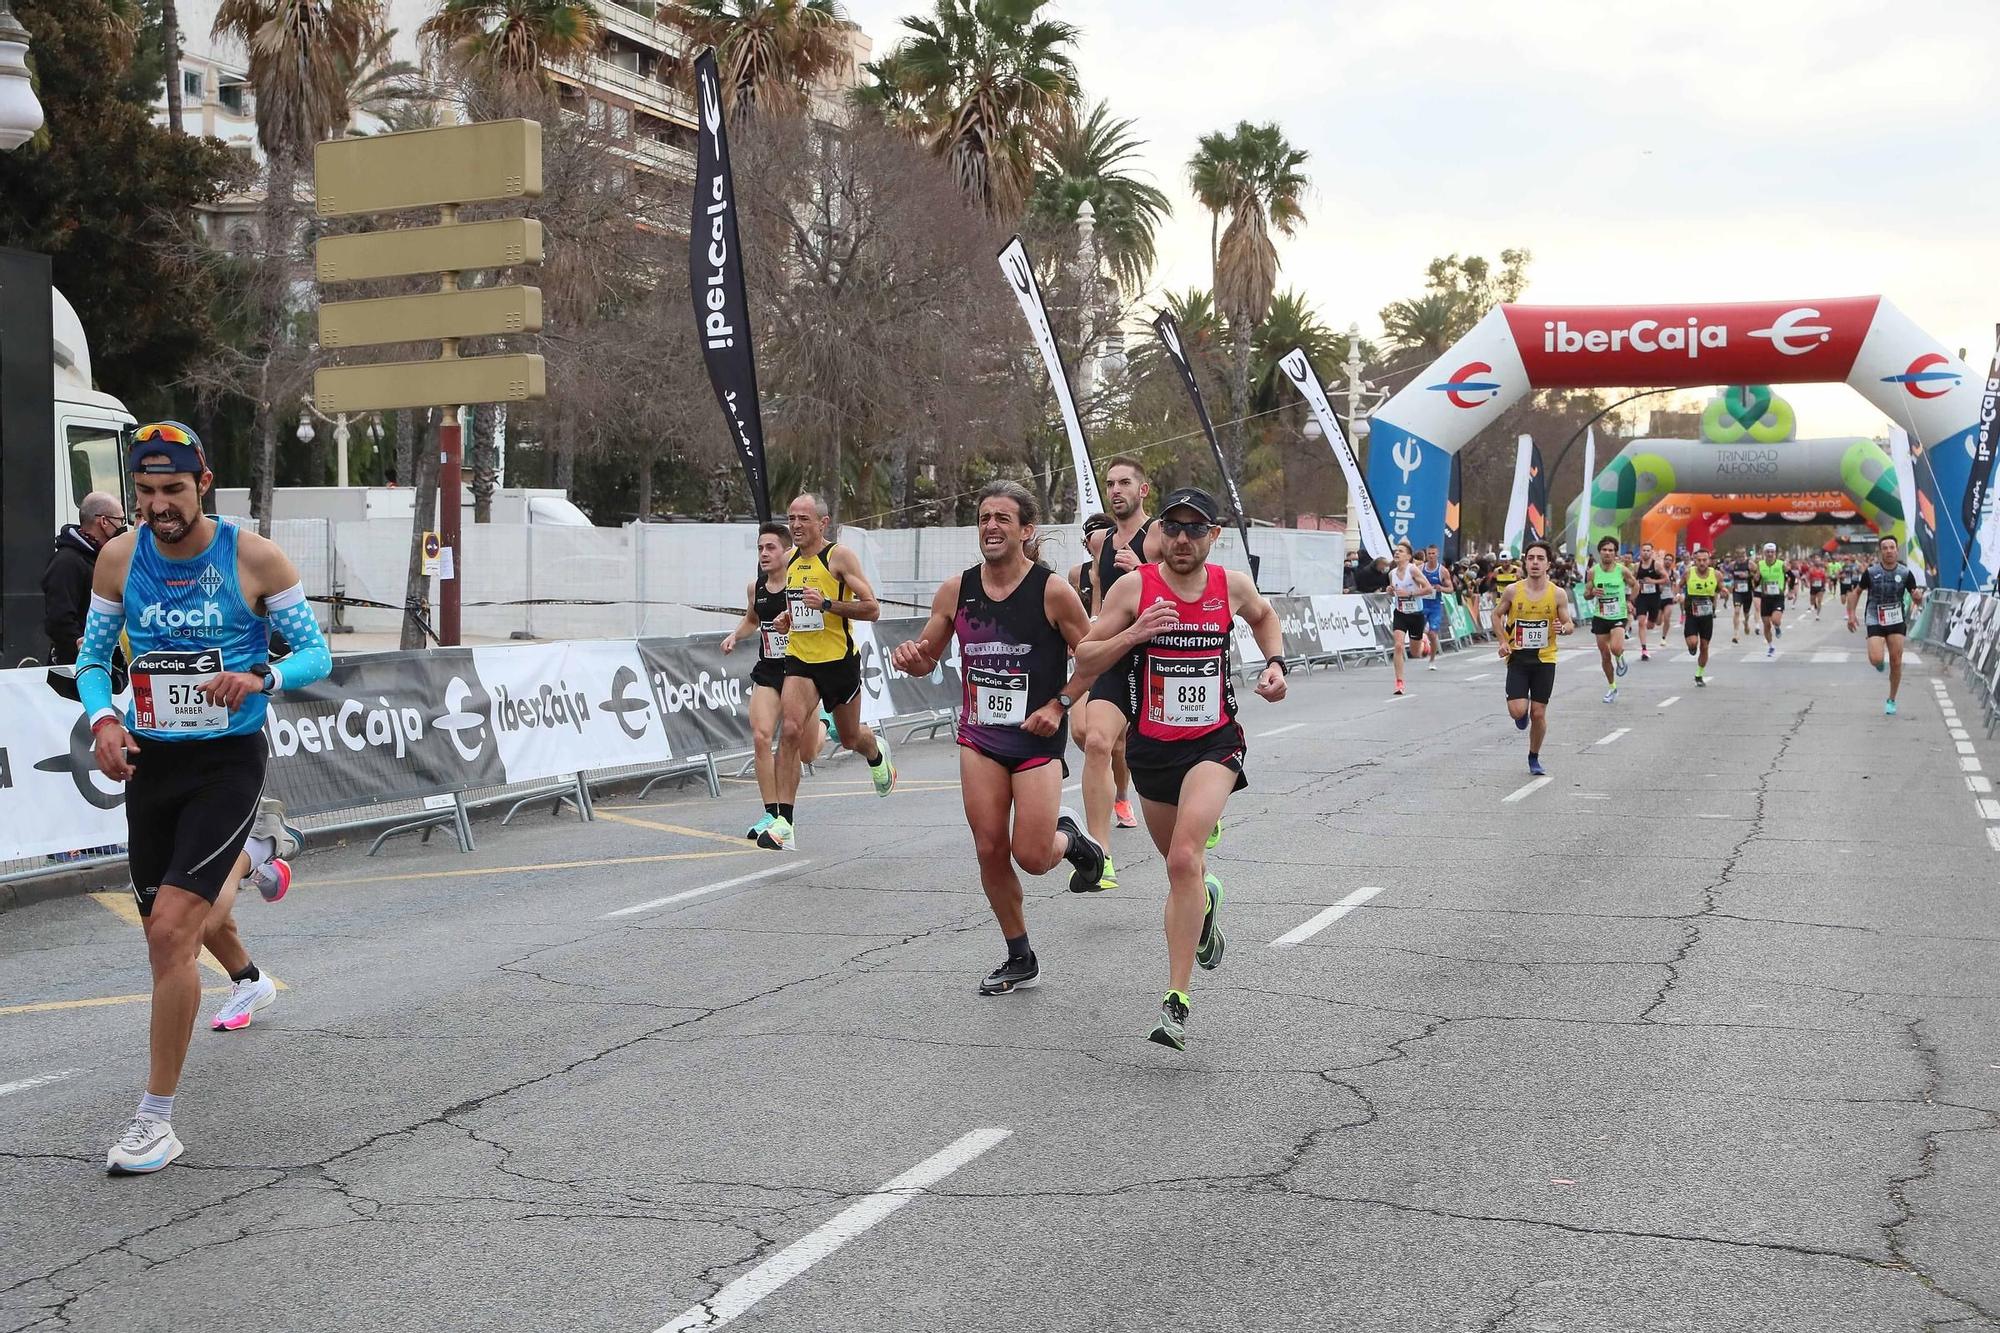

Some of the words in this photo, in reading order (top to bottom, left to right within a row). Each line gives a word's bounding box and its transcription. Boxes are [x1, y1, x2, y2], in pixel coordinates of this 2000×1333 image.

[1544, 316, 1728, 359] iberCaja
[1716, 450, 1779, 462] TRINIDAD
[1716, 462, 1779, 474] ALFONSO
[1791, 499, 1841, 509] seguros
[168, 626, 223, 638] logistic
[1201, 622, 1220, 632] club
[1528, 631, 1542, 639] 676
[1150, 635, 1224, 648] MANCHATHON
[973, 659, 1020, 667] ALZIRA
[1156, 664, 1196, 675] iberCaja
[971, 674, 1003, 687] iberCaja
[168, 684, 204, 705] 573
[654, 667, 742, 716] iberCaja
[1178, 686, 1207, 703] 838
[494, 679, 591, 734] iberCaja
[988, 695, 1012, 712] 856
[174, 706, 203, 714] BARBER
[261, 696, 423, 759] berCaja
